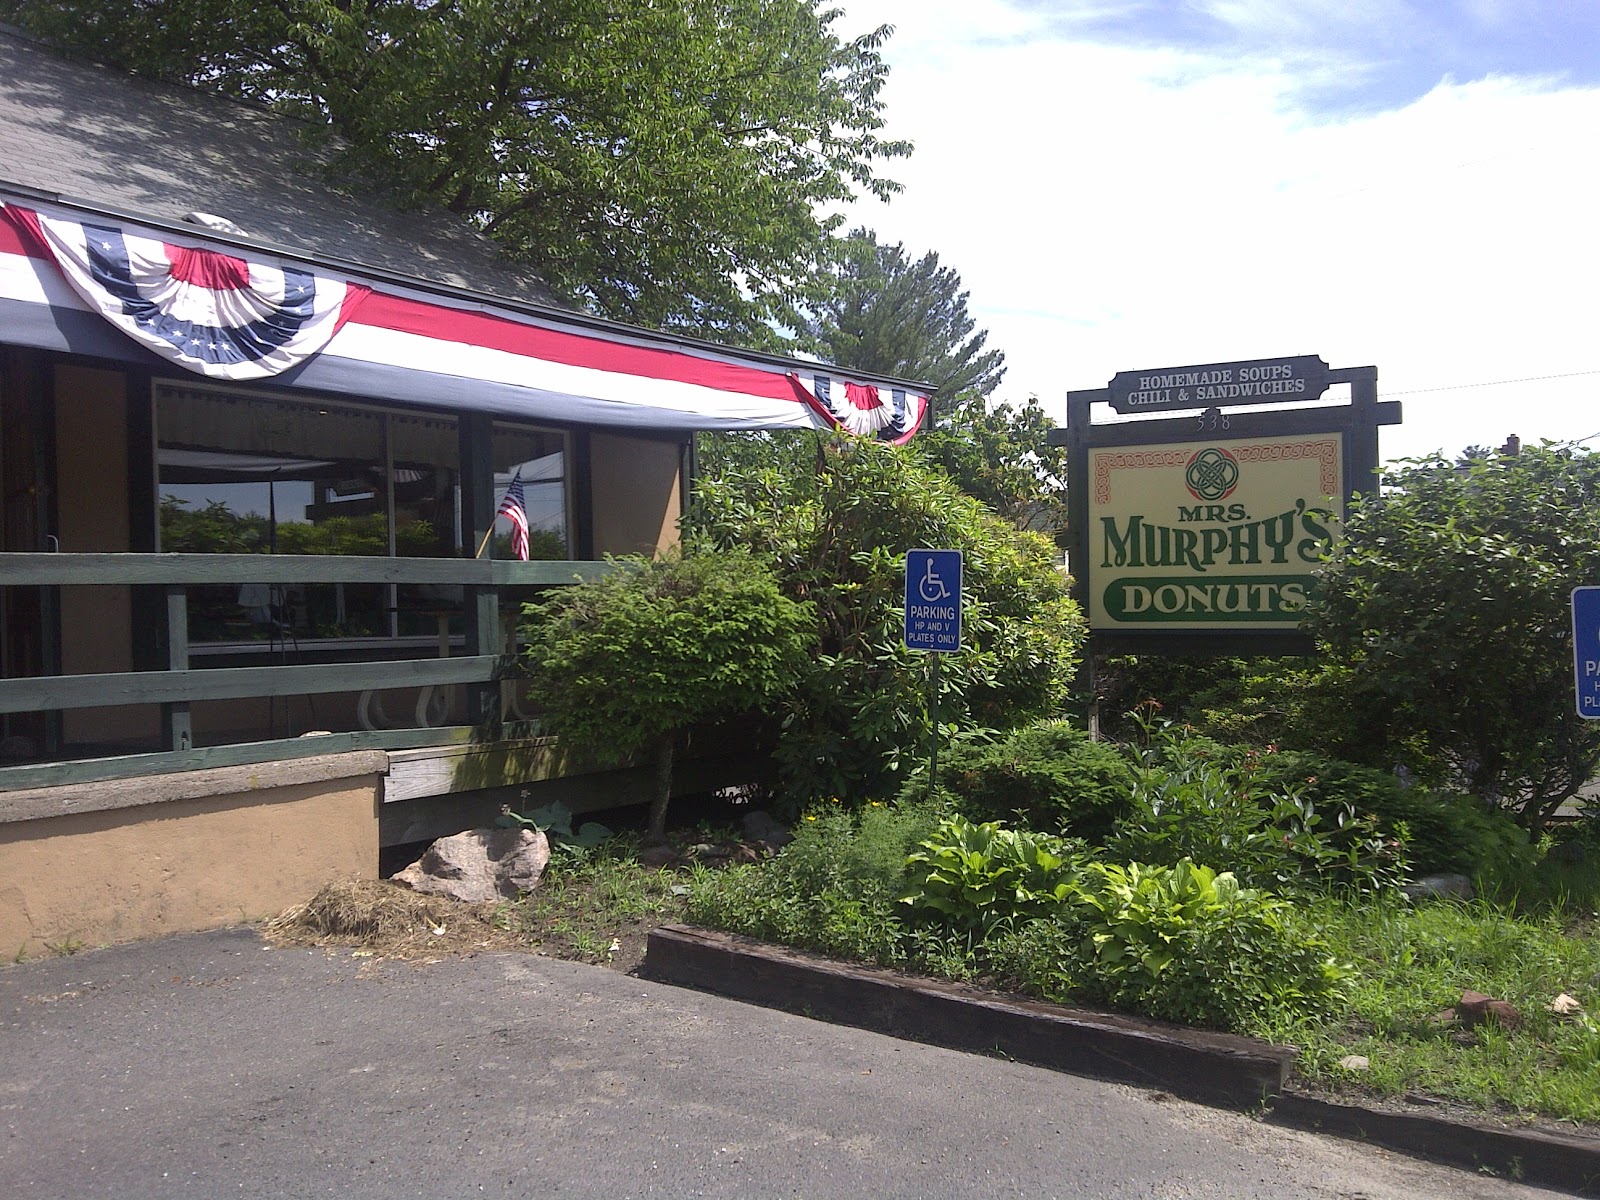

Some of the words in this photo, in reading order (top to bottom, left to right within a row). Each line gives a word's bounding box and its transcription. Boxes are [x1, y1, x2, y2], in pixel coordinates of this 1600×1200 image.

[1139, 369, 1232, 390] HOMEMADE
[1239, 365, 1292, 382] SOUPS
[1127, 389, 1171, 405] CHILI
[1177, 388, 1189, 401] &
[1196, 378, 1305, 400] SANDWICHES
[1196, 414, 1230, 431] 538
[1178, 503, 1252, 522] MRS.
[1121, 583, 1307, 613] DONUTS
[910, 605, 955, 620] PARKING
[915, 621, 925, 630] HP
[927, 622, 942, 631] AND
[944, 622, 950, 631] V
[908, 632, 935, 643] PLATES
[937, 634, 956, 644] ONLY
[1584, 696, 1600, 707] PL
